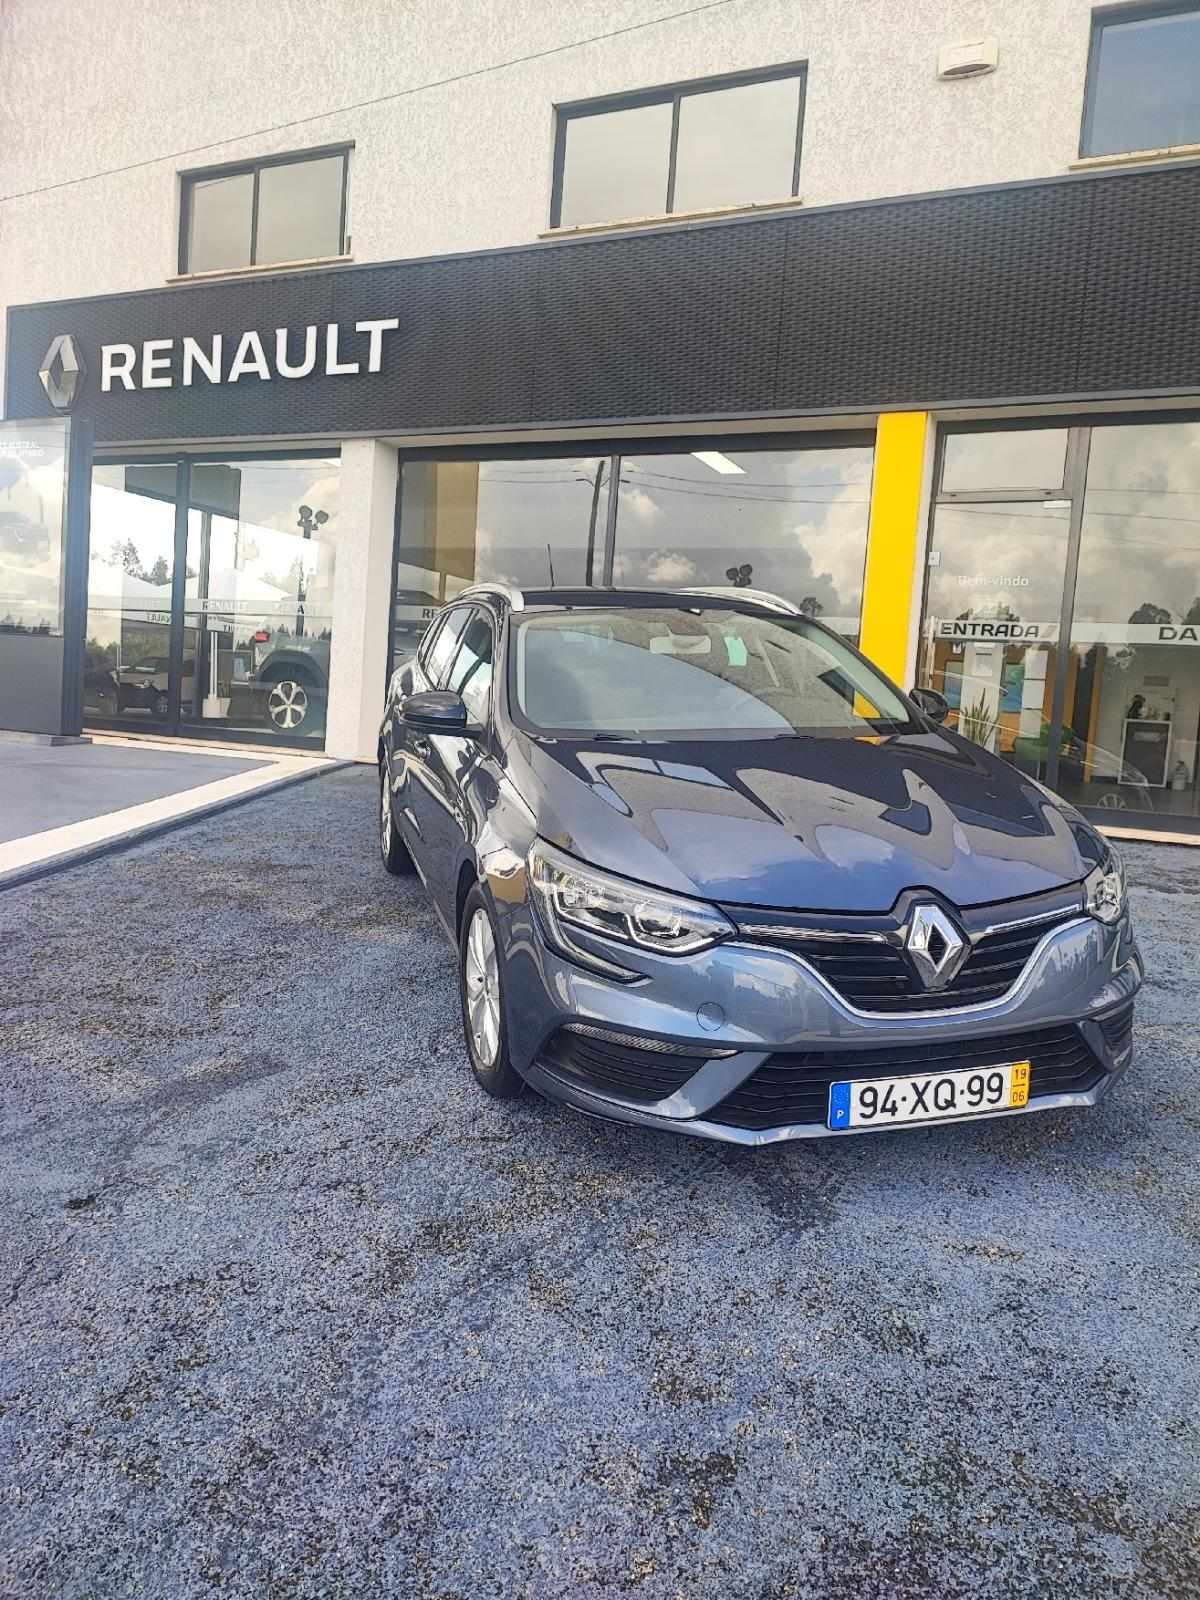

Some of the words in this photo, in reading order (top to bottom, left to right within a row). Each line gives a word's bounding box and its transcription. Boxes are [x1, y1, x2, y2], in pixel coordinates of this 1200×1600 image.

[101, 318, 399, 392] RENAULT
[957, 576, 1029, 586] Bem-vindo
[940, 622, 1039, 638] ENTRADA
[1159, 626, 1198, 640] DA
[1015, 1068, 1027, 1080] 19
[1012, 1090, 1025, 1103] 06
[836, 1109, 845, 1120] P
